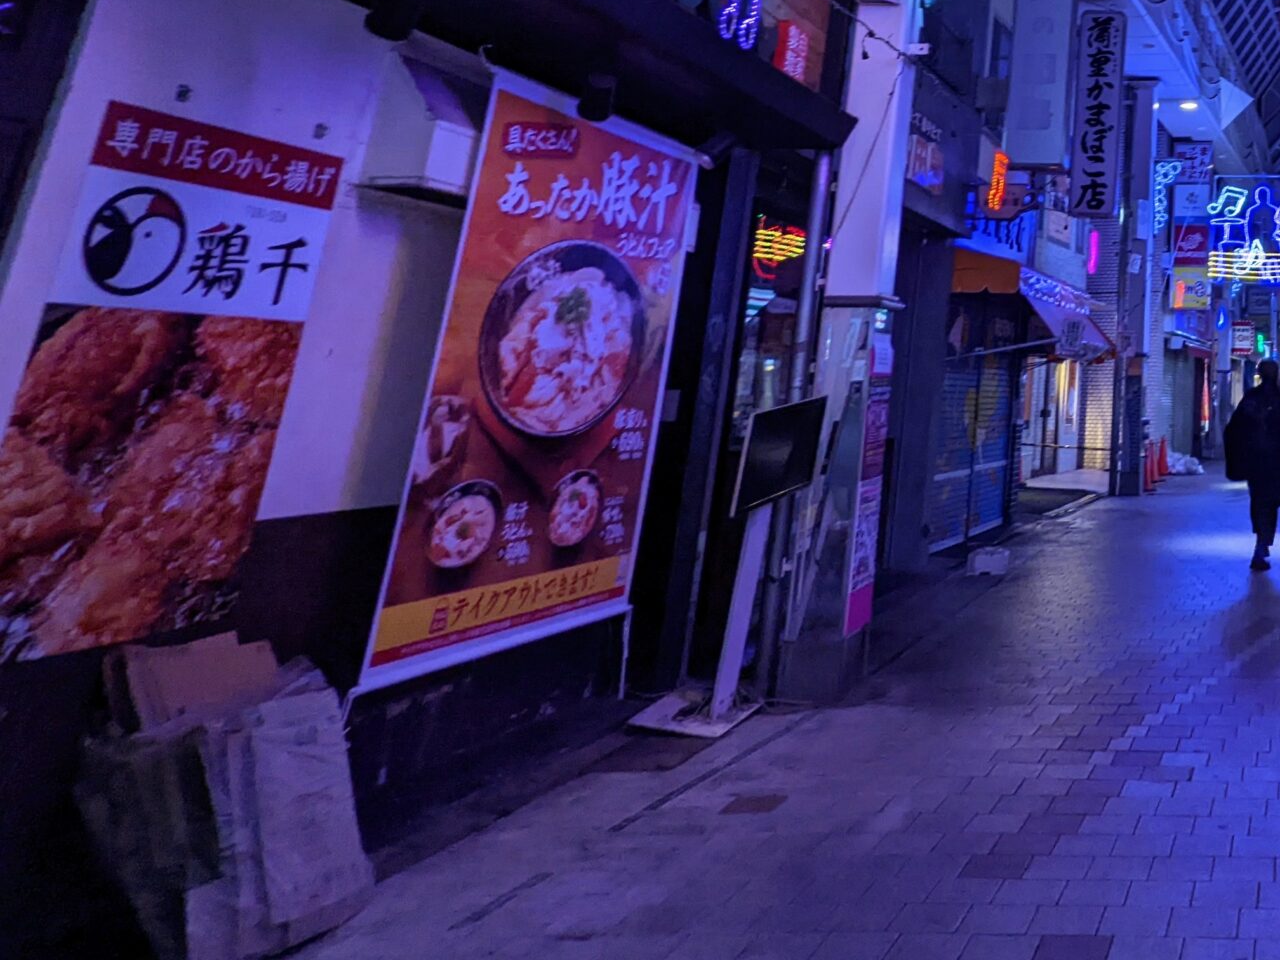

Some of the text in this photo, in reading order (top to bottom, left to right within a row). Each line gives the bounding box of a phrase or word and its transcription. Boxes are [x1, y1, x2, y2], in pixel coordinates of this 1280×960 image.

[106, 118, 336, 198] 専門店のから揚げ
[496, 150, 678, 234] あったか豚汁
[183, 222, 309, 305] 鶏千
[450, 565, 600, 627] テイクアウトできます!
